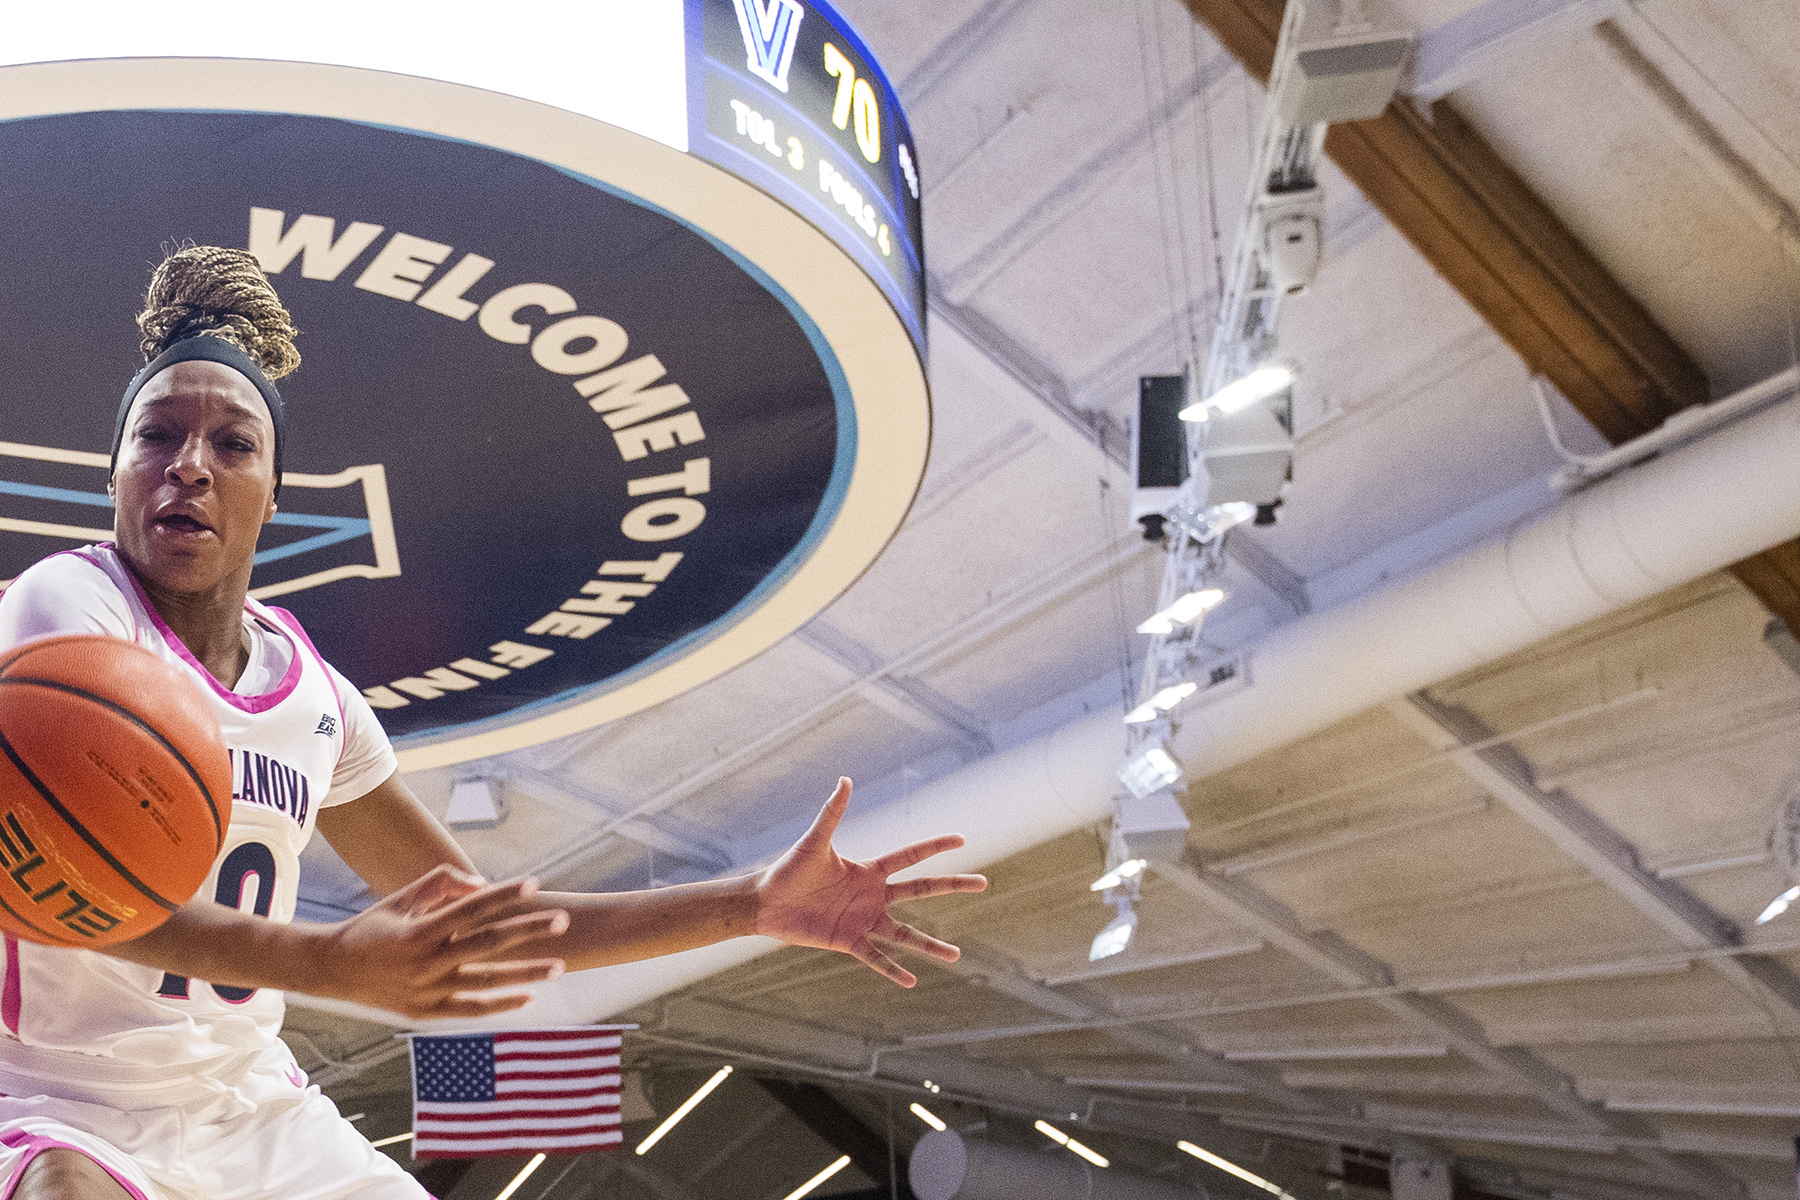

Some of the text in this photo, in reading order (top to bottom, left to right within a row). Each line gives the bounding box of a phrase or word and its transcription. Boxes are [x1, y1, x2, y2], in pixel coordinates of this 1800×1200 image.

[824, 42, 881, 163] 70
[730, 99, 782, 157] TOL
[787, 136, 804, 170] 3
[819, 159, 877, 237] FOULS
[248, 207, 706, 462] WELCOME
[620, 457, 711, 542] TO
[525, 551, 684, 640] THE
[317, 721, 336, 736] EAST
[321, 713, 336, 727] BIG
